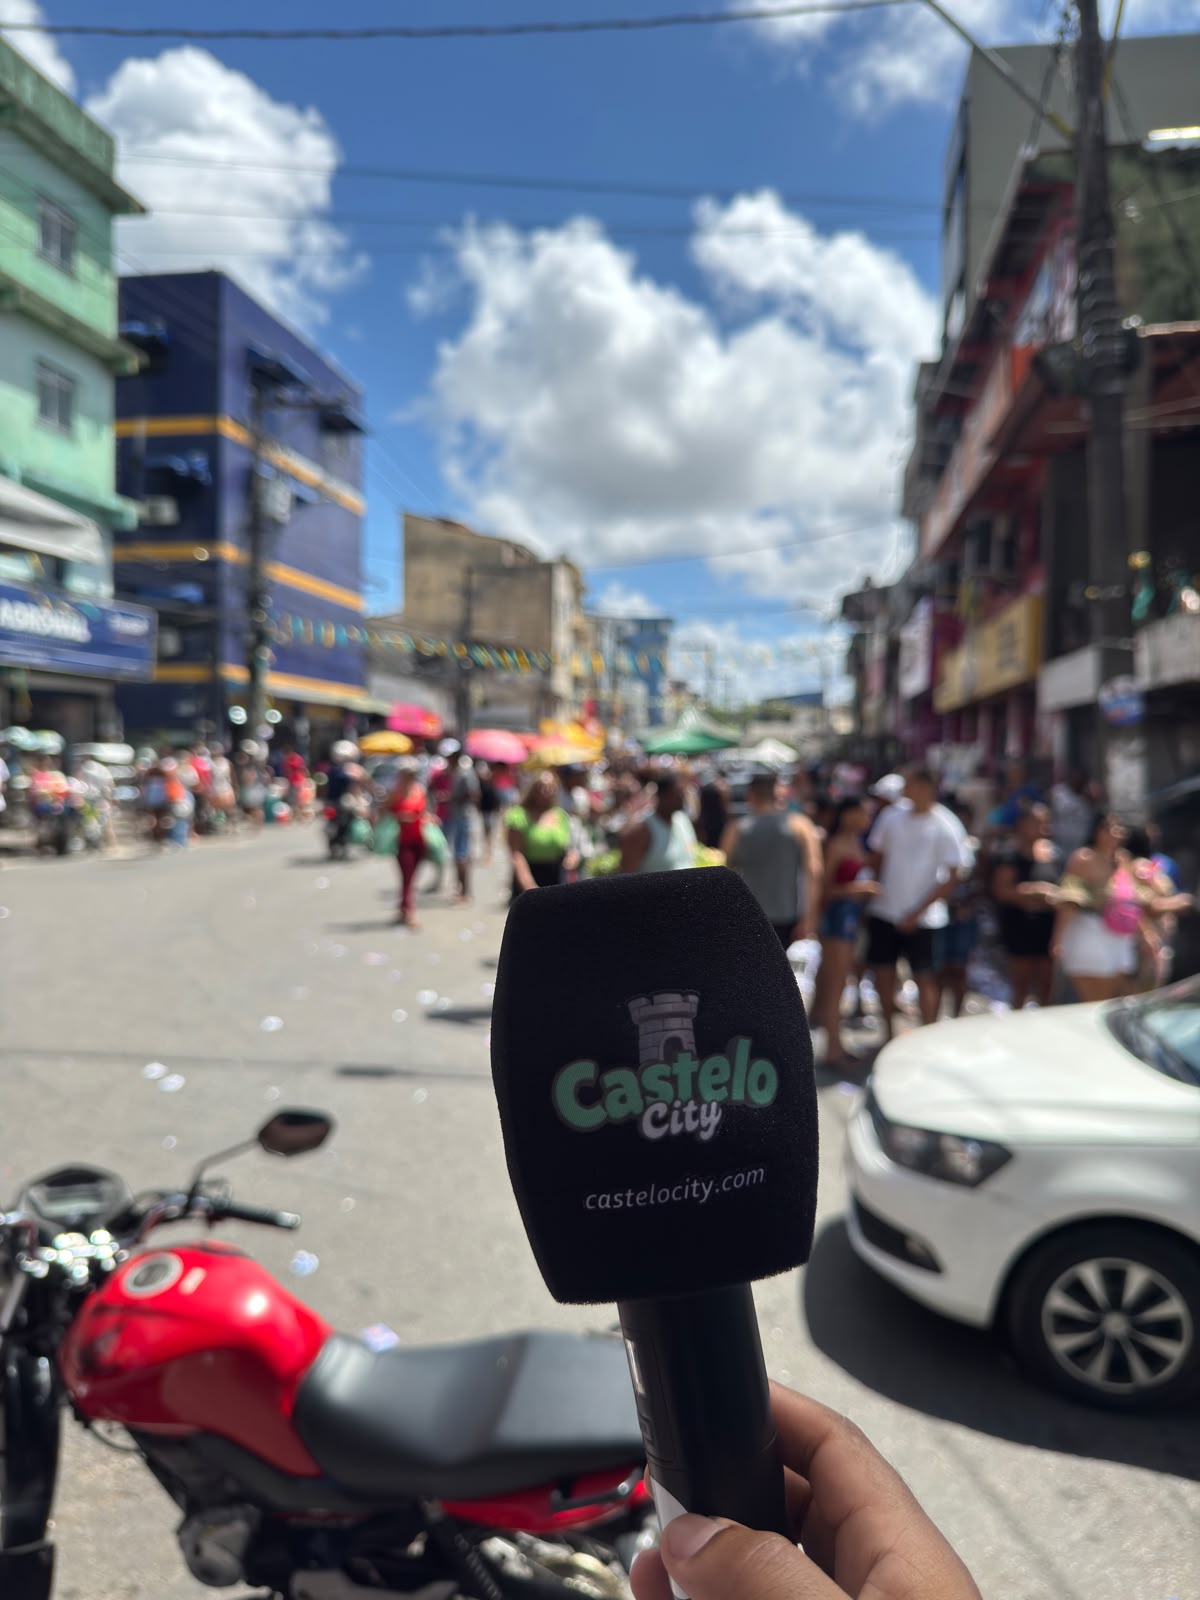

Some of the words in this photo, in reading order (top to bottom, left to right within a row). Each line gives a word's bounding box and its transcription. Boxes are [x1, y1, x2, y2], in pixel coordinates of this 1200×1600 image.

[553, 1037, 778, 1128] Castelo
[641, 1100, 722, 1140] City
[585, 1167, 765, 1210] castelocity.com
